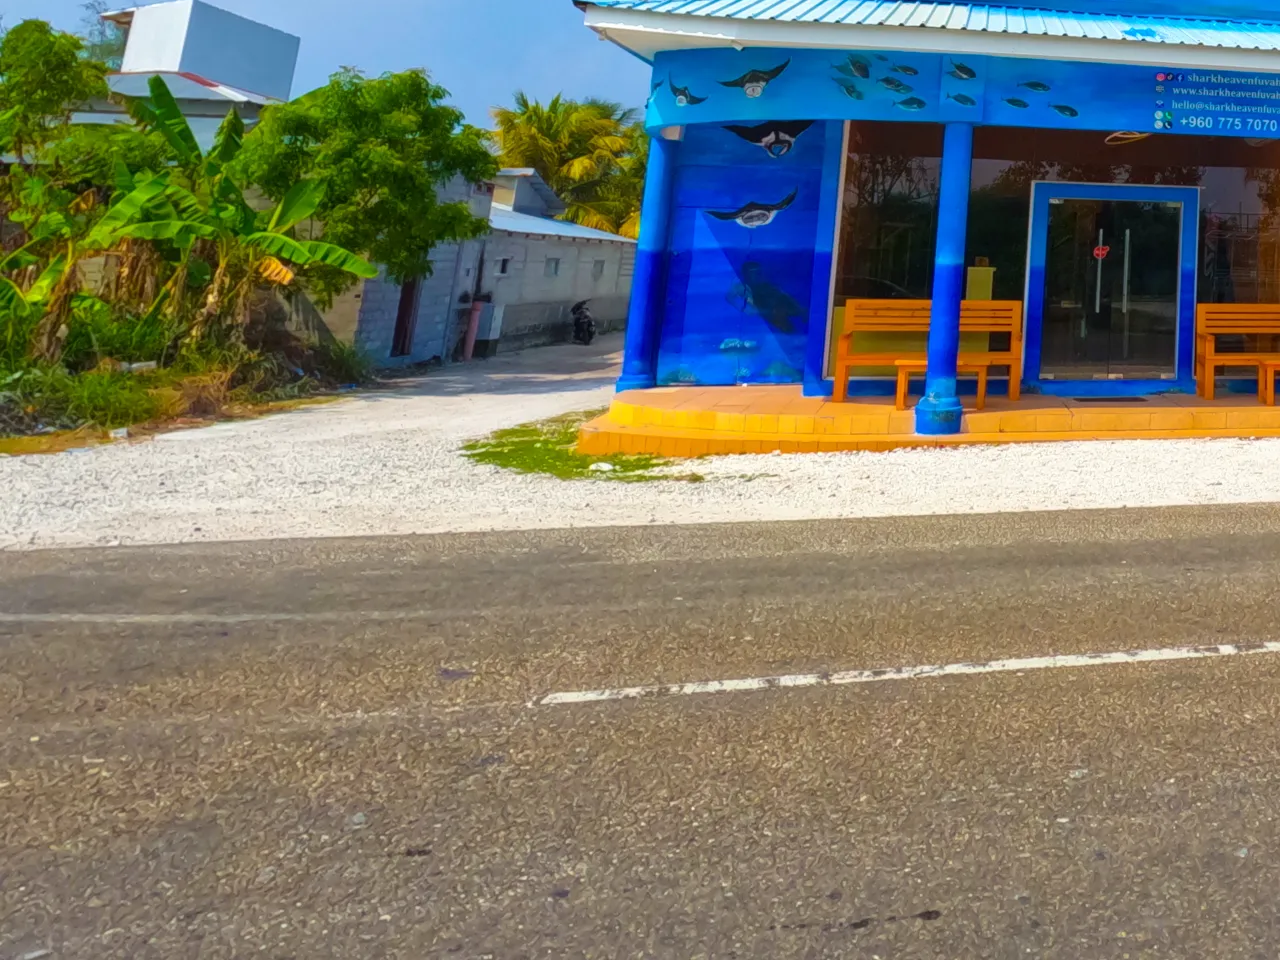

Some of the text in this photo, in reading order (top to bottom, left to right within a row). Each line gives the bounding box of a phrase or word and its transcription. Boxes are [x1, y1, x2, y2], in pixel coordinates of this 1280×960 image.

[1180, 116, 1278, 132] +960 775 7070
